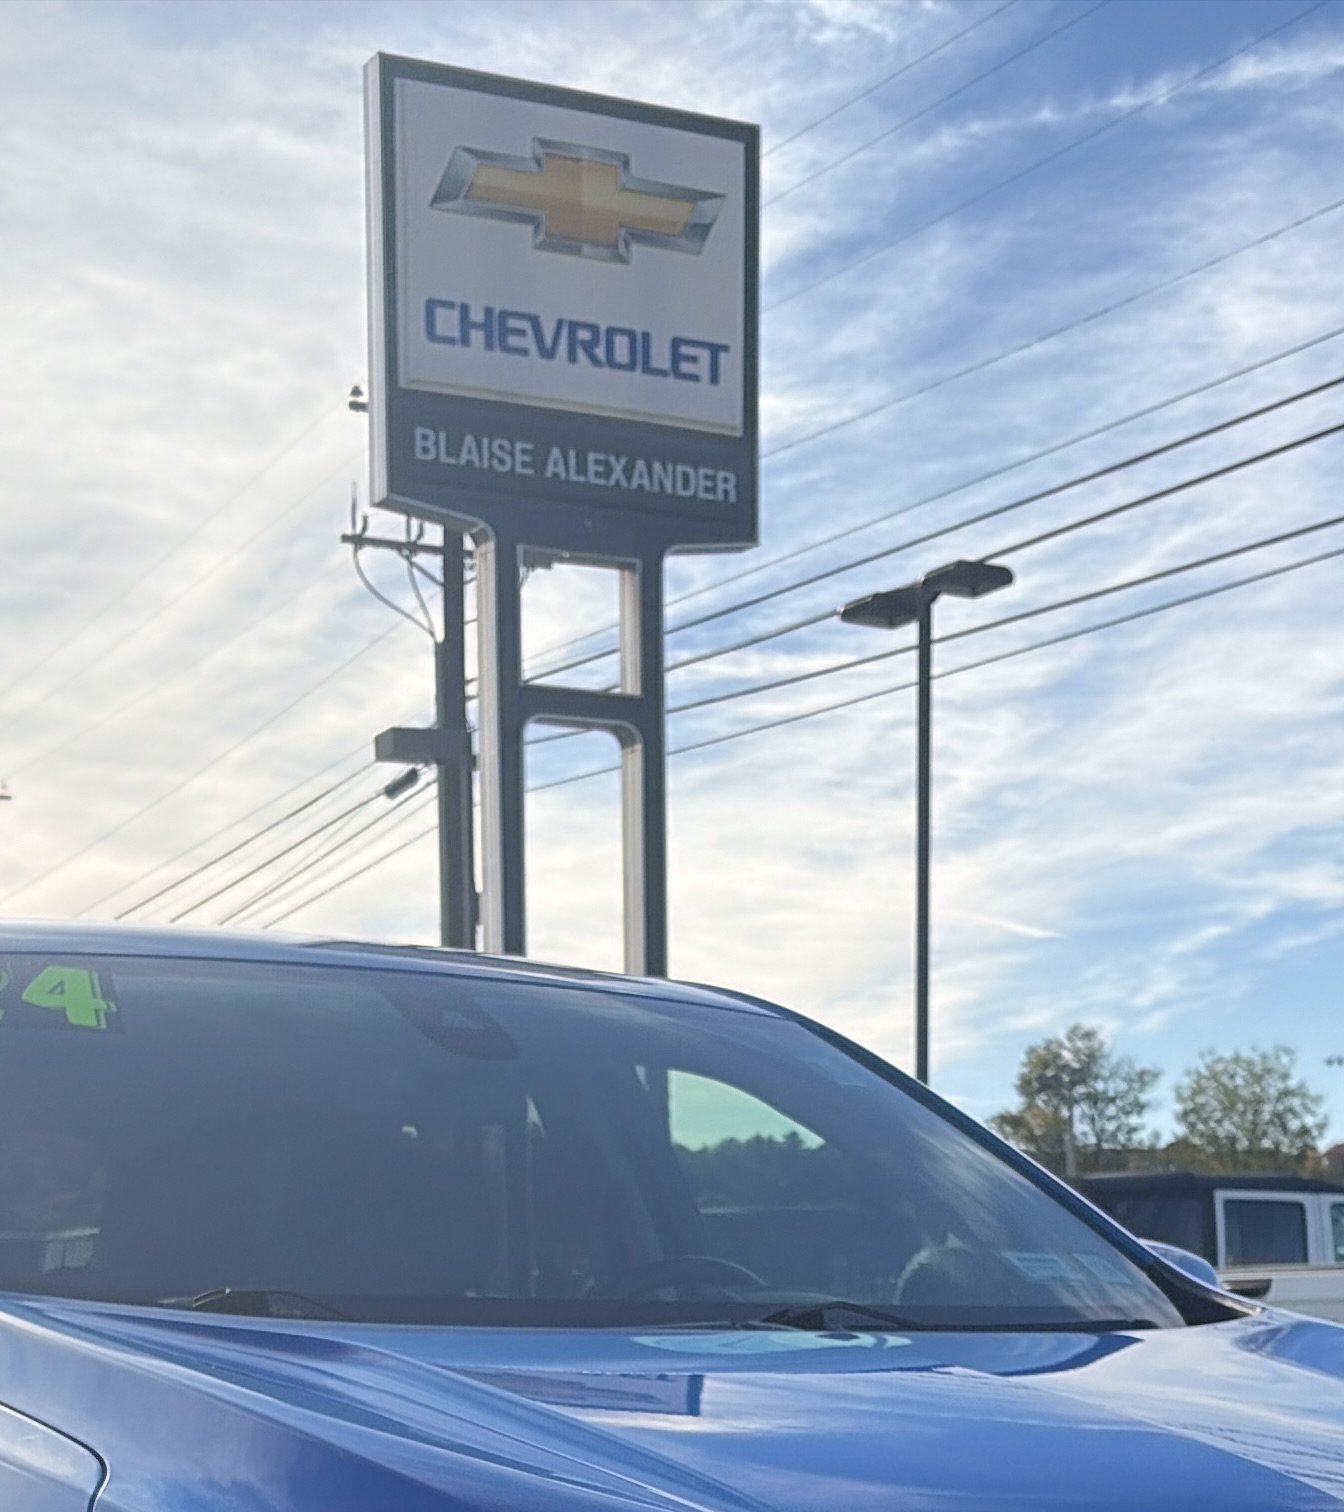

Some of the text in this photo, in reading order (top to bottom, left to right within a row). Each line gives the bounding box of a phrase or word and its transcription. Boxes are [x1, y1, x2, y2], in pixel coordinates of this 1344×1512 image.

[424, 297, 729, 386] CHEVROLET
[414, 427, 737, 503] BLAISE ALEXANDER
